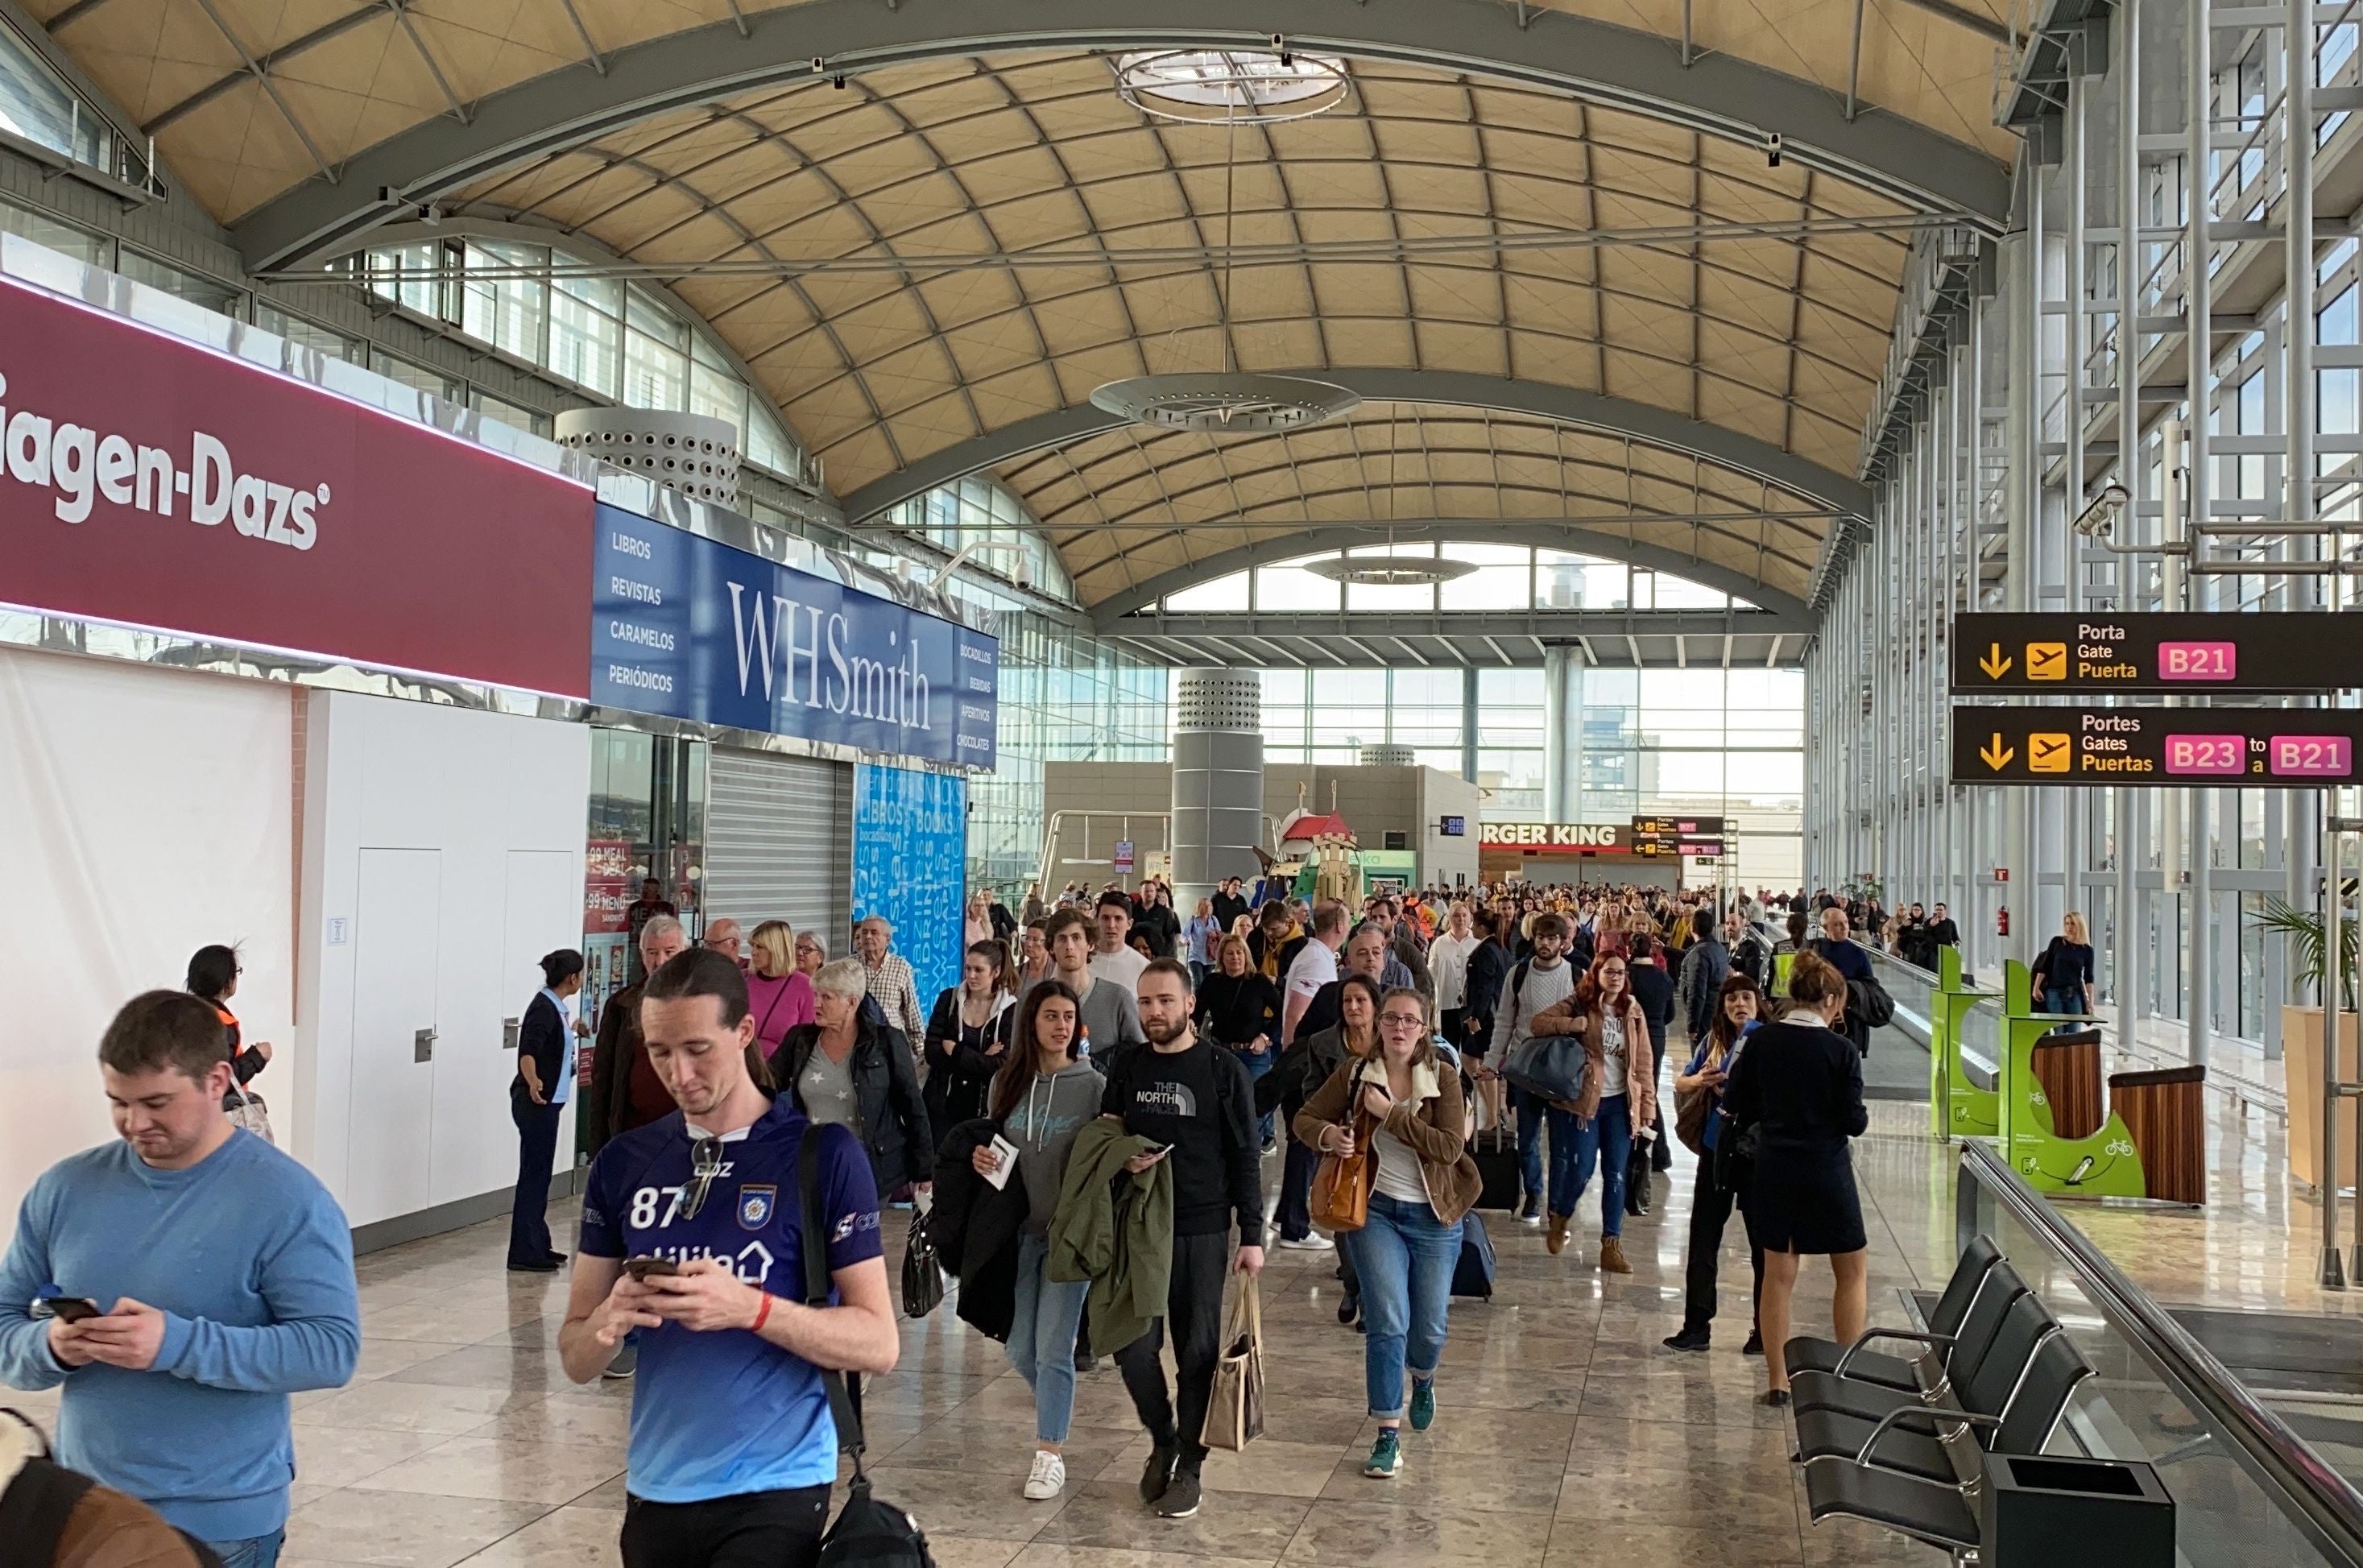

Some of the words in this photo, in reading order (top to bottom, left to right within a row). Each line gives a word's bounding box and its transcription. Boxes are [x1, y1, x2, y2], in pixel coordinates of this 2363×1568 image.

[612, 532, 651, 560] LIBROS
[612, 575, 661, 606] REVISTAS
[610, 620, 675, 652] CARAMELOS
[2078, 624, 2125, 640] Porta
[727, 581, 931, 730] WHSmith
[960, 643, 991, 665] BOCADILLOS
[2078, 643, 2113, 659] Gate
[2169, 648, 2227, 673] B21
[610, 664, 672, 693] PERIÓDICOS
[2078, 662, 2137, 678] Puerta
[970, 676, 991, 693] BEBIDAS
[962, 704, 990, 722] APERITIVOS
[2082, 714, 2141, 731] Portes
[957, 734, 990, 751] CHOCOLATES
[2082, 736, 2128, 751] Gates
[2249, 738, 2266, 752] to
[2082, 755, 2154, 772] Puertas
[2174, 742, 2236, 767] B23
[2253, 759, 2264, 773] a
[2280, 743, 2342, 769] B21
[859, 797, 904, 825] LIBROS
[916, 807, 953, 835] BOOKS
[1479, 824, 1547, 844] RGER
[1553, 825, 1616, 846] KING
[603, 847, 627, 862] MEAL
[888, 831, 901, 956] vistas
[921, 840, 933, 963] DRINKS
[946, 817, 961, 988] dwiches
[912, 840, 925, 994] gazines
[940, 842, 950, 991] EWSPAPERS
[1136, 1090, 1176, 1104] NORTH
[1154, 1082, 1176, 1093] THE
[630, 1186, 681, 1230] 87
